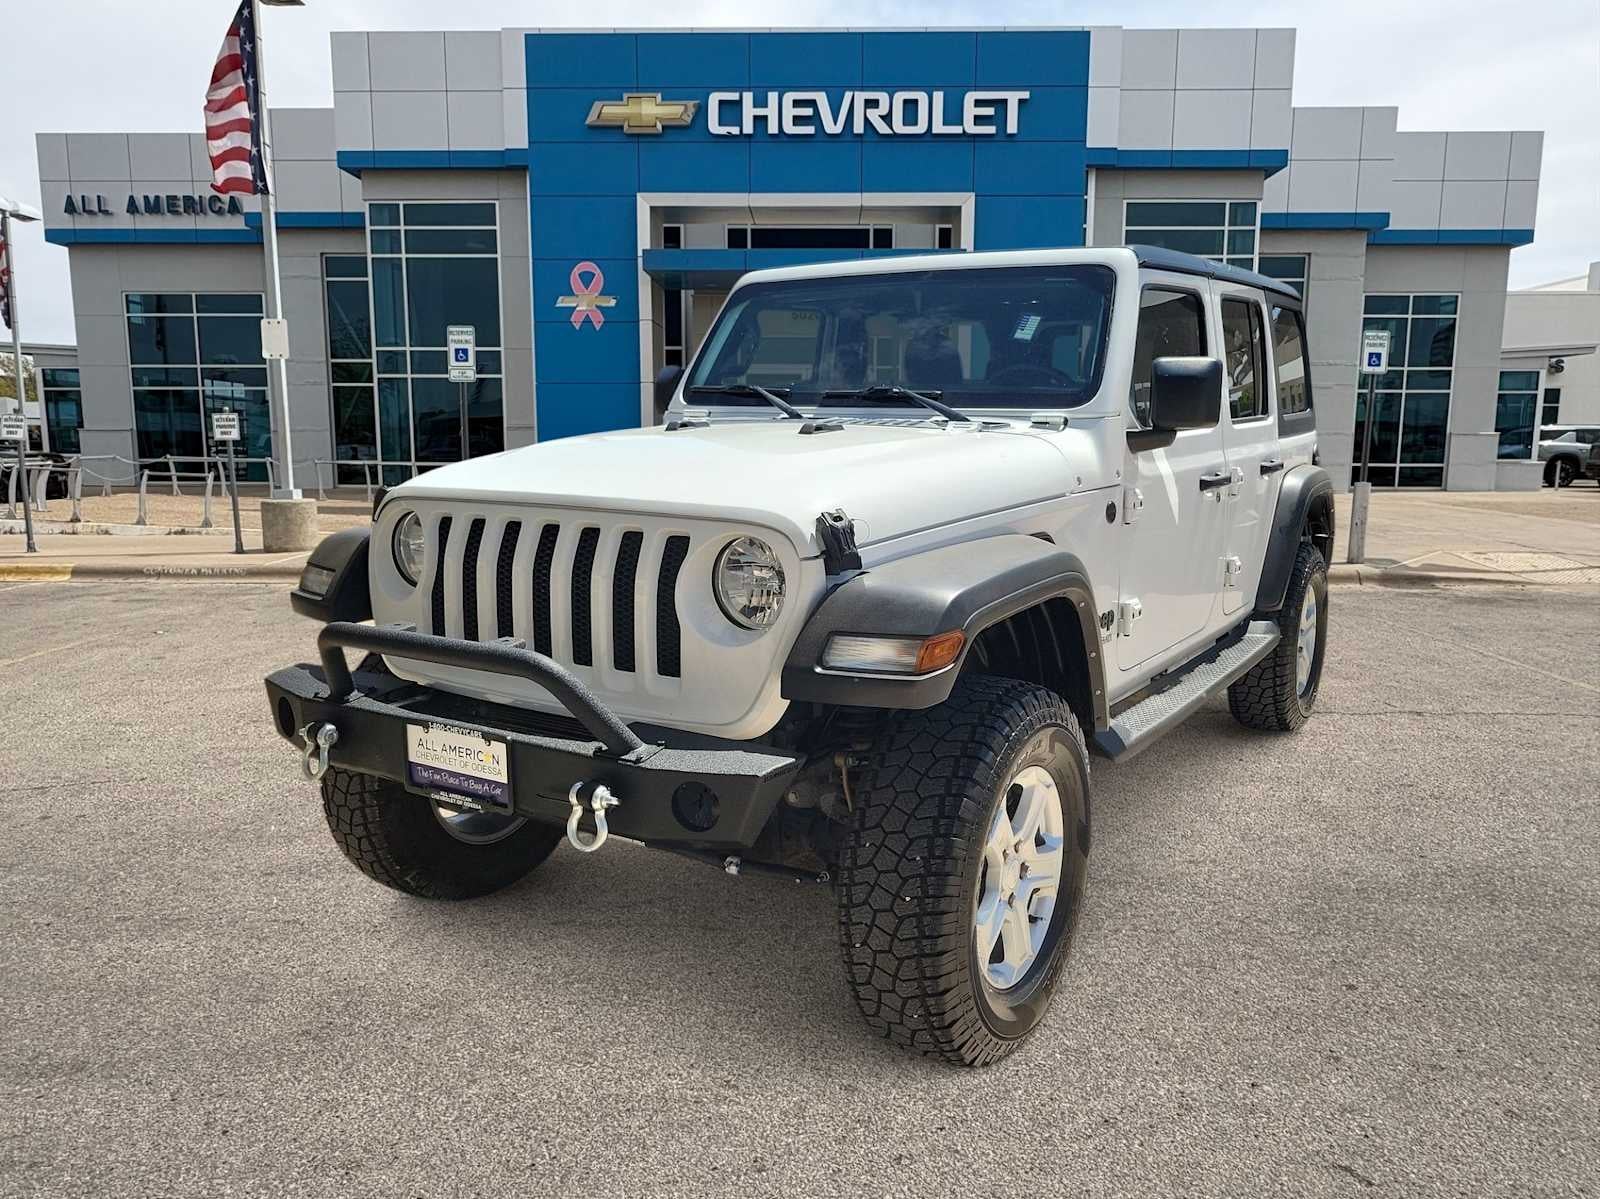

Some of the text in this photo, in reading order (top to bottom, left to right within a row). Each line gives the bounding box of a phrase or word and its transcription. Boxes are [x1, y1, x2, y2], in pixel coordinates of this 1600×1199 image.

[707, 90, 1030, 135] CHEVROLET
[64, 194, 244, 215] ALL AMERICA
[415, 750, 503, 777] CHEVROLET OF ODESSA
[418, 738, 500, 766] ALL AMERICN
[417, 767, 502, 796] The Fun Place To Buy A Car
